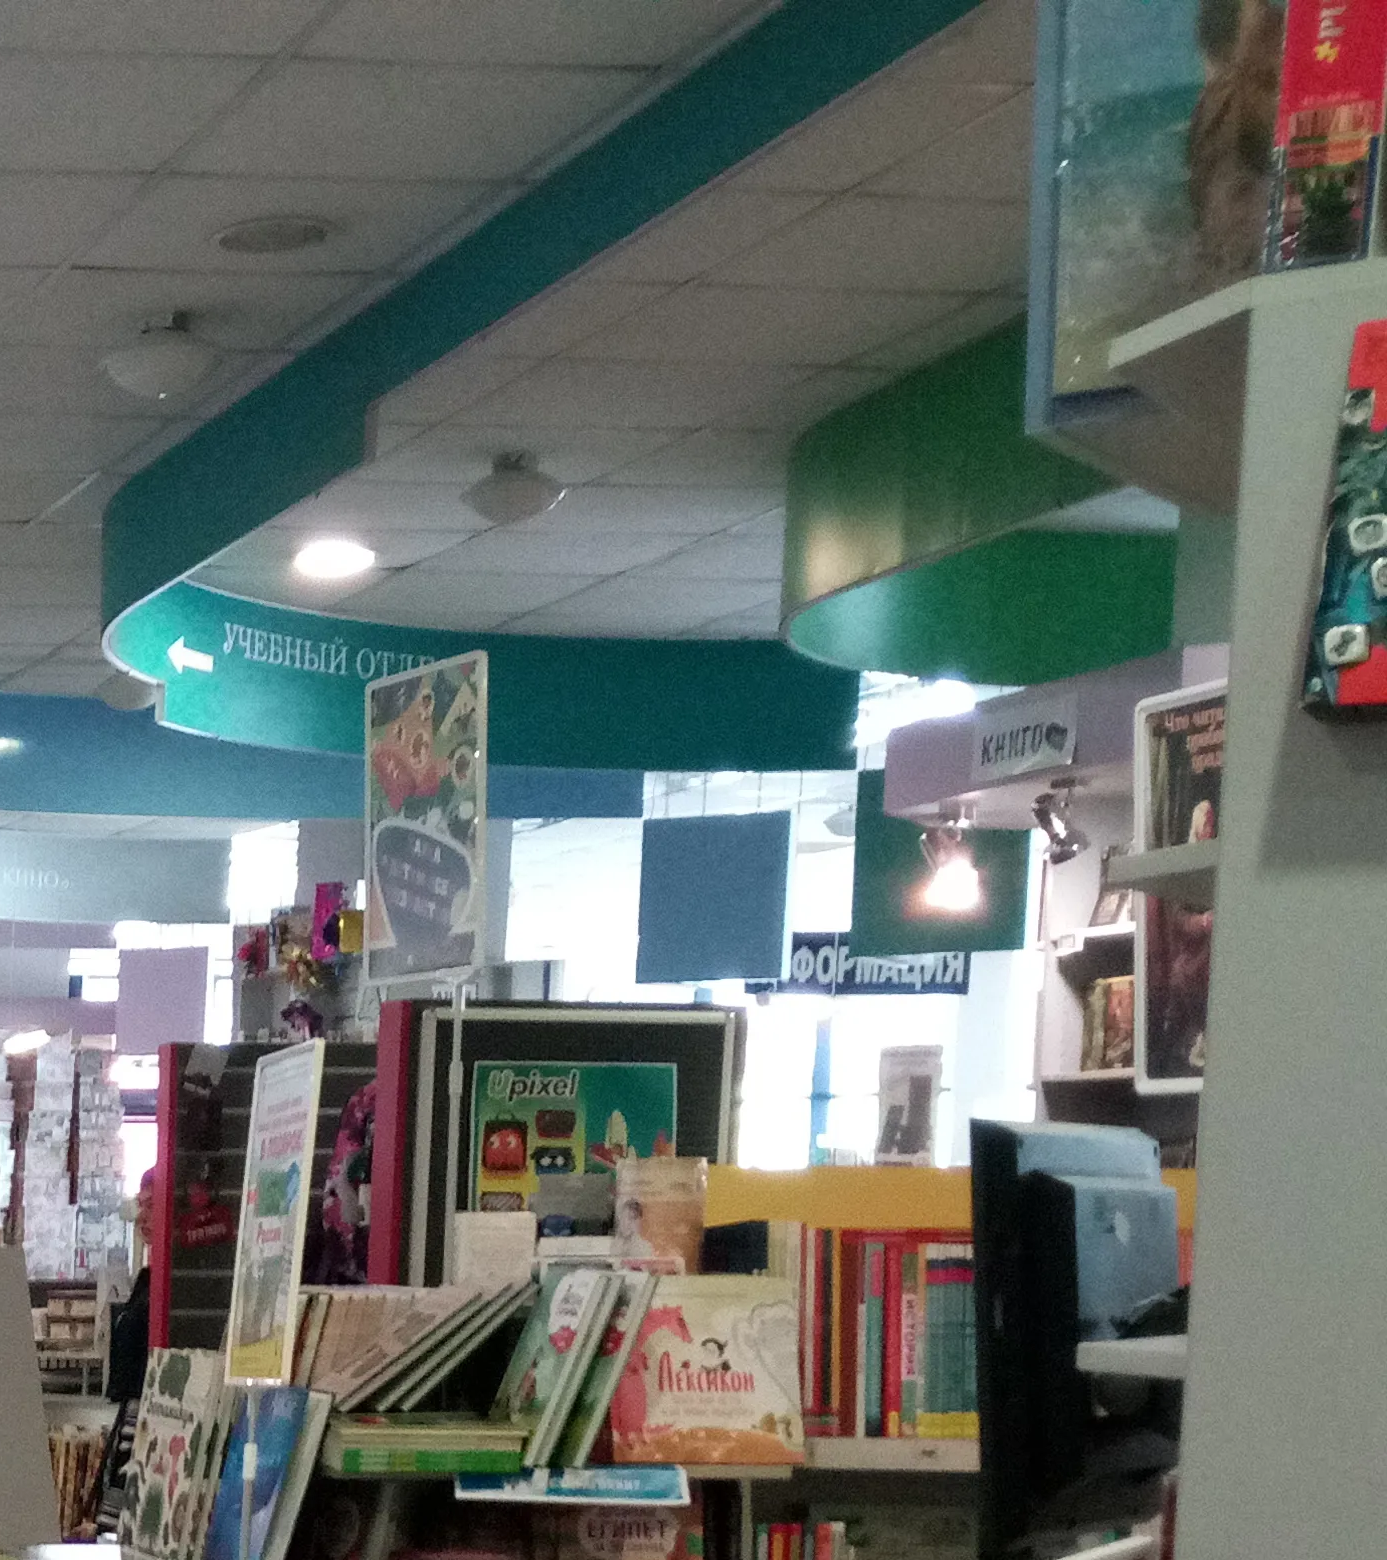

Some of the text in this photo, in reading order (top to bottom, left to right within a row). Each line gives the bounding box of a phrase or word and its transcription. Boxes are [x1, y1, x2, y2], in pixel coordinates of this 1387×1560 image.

[223, 622, 434, 681] УЧЕБНЫЙ ОТД
[791, 945, 967, 992] ФОРМАЦИЯ
[487, 1068, 579, 1102] Upixel
